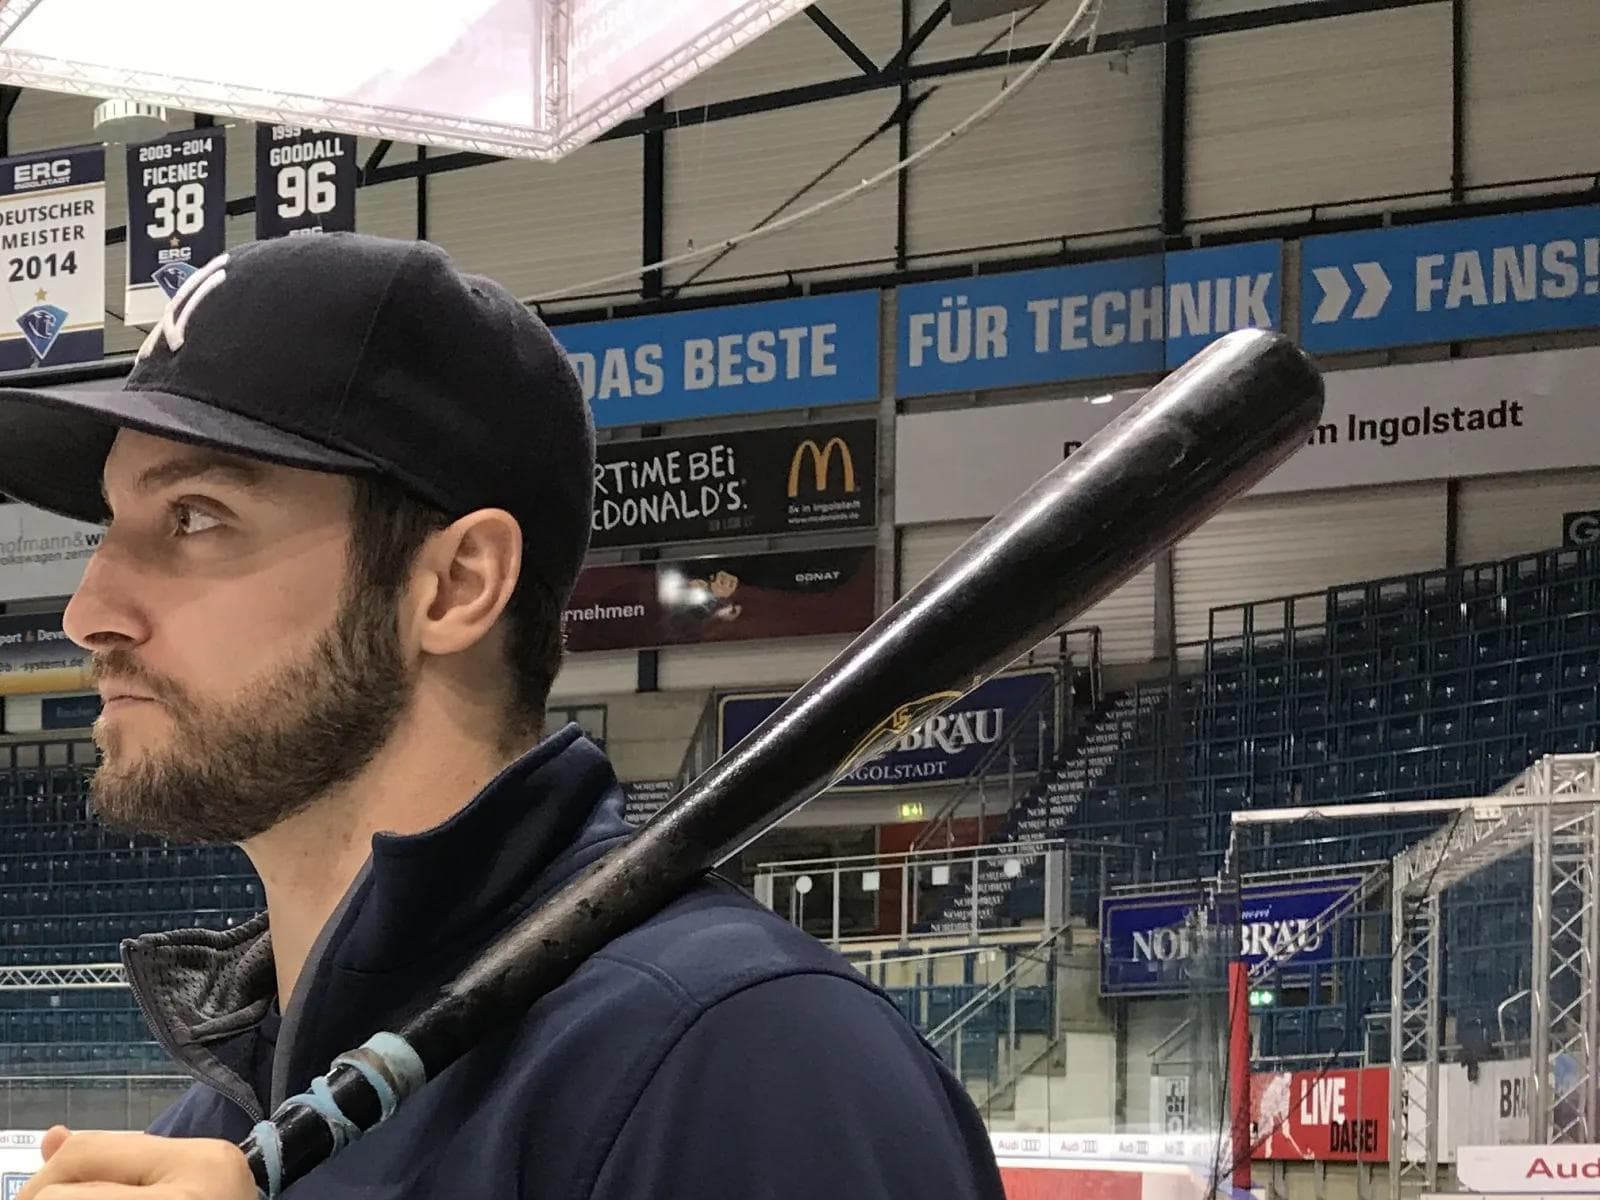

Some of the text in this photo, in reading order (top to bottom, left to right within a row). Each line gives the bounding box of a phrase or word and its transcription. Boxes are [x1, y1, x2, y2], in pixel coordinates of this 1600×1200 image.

[270, 137, 345, 167] GOODALL
[14, 158, 72, 183] ERC
[143, 160, 209, 188] FICENEC
[276, 161, 337, 219] 96
[146, 183, 205, 240] 38
[2, 225, 85, 251] MEISTER
[158, 246, 192, 260] ERC
[8, 250, 78, 283] 2014
[1415, 238, 1600, 313] FANS!
[908, 272, 1273, 369] FÜR TECHNIK
[683, 323, 838, 392] BESTE
[1348, 400, 1524, 446] Ingolstadt
[593, 450, 681, 496] RTiME
[566, 602, 645, 622] rnehmen
[855, 760, 947, 780] GOLSTADT
[1526, 1157, 1600, 1179] Aud
